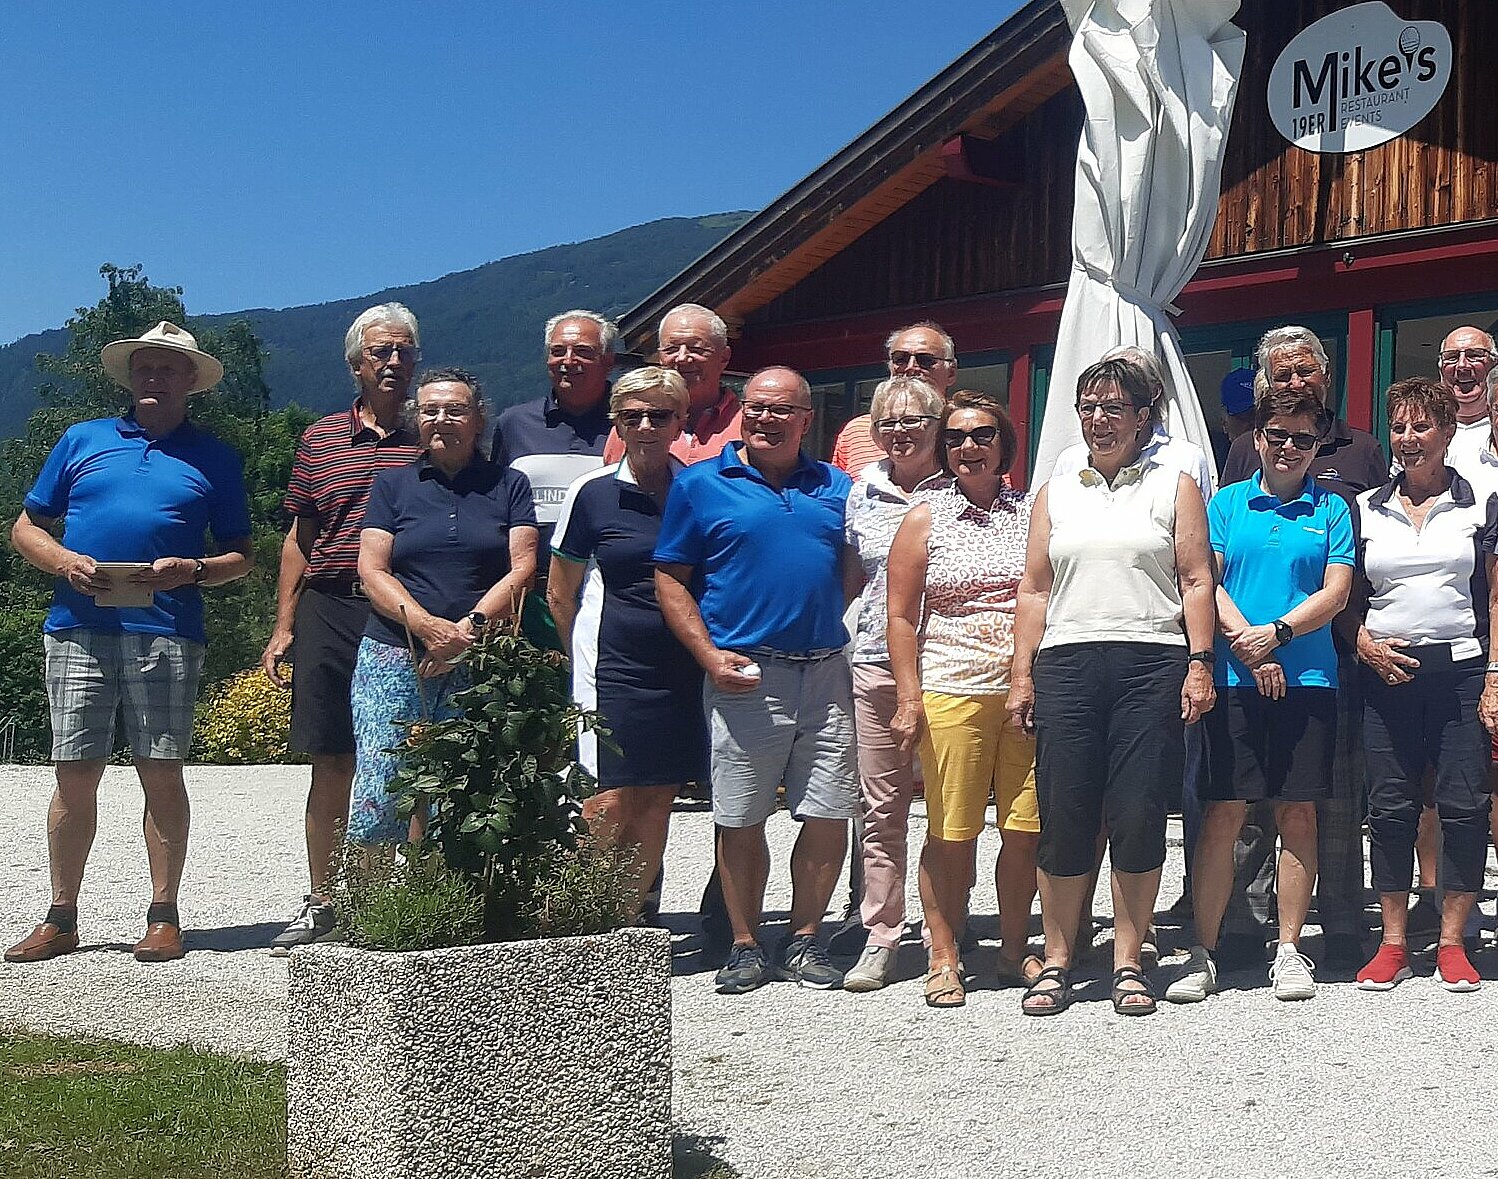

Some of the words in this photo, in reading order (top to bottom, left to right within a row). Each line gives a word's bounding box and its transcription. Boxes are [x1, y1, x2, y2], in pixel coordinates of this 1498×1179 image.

[1293, 28, 1437, 132] Mike's
[1341, 88, 1410, 114] RESTAURANT
[1292, 113, 1325, 139] 19ER
[1341, 109, 1382, 130] EVENTS
[534, 489, 567, 502] LIND
